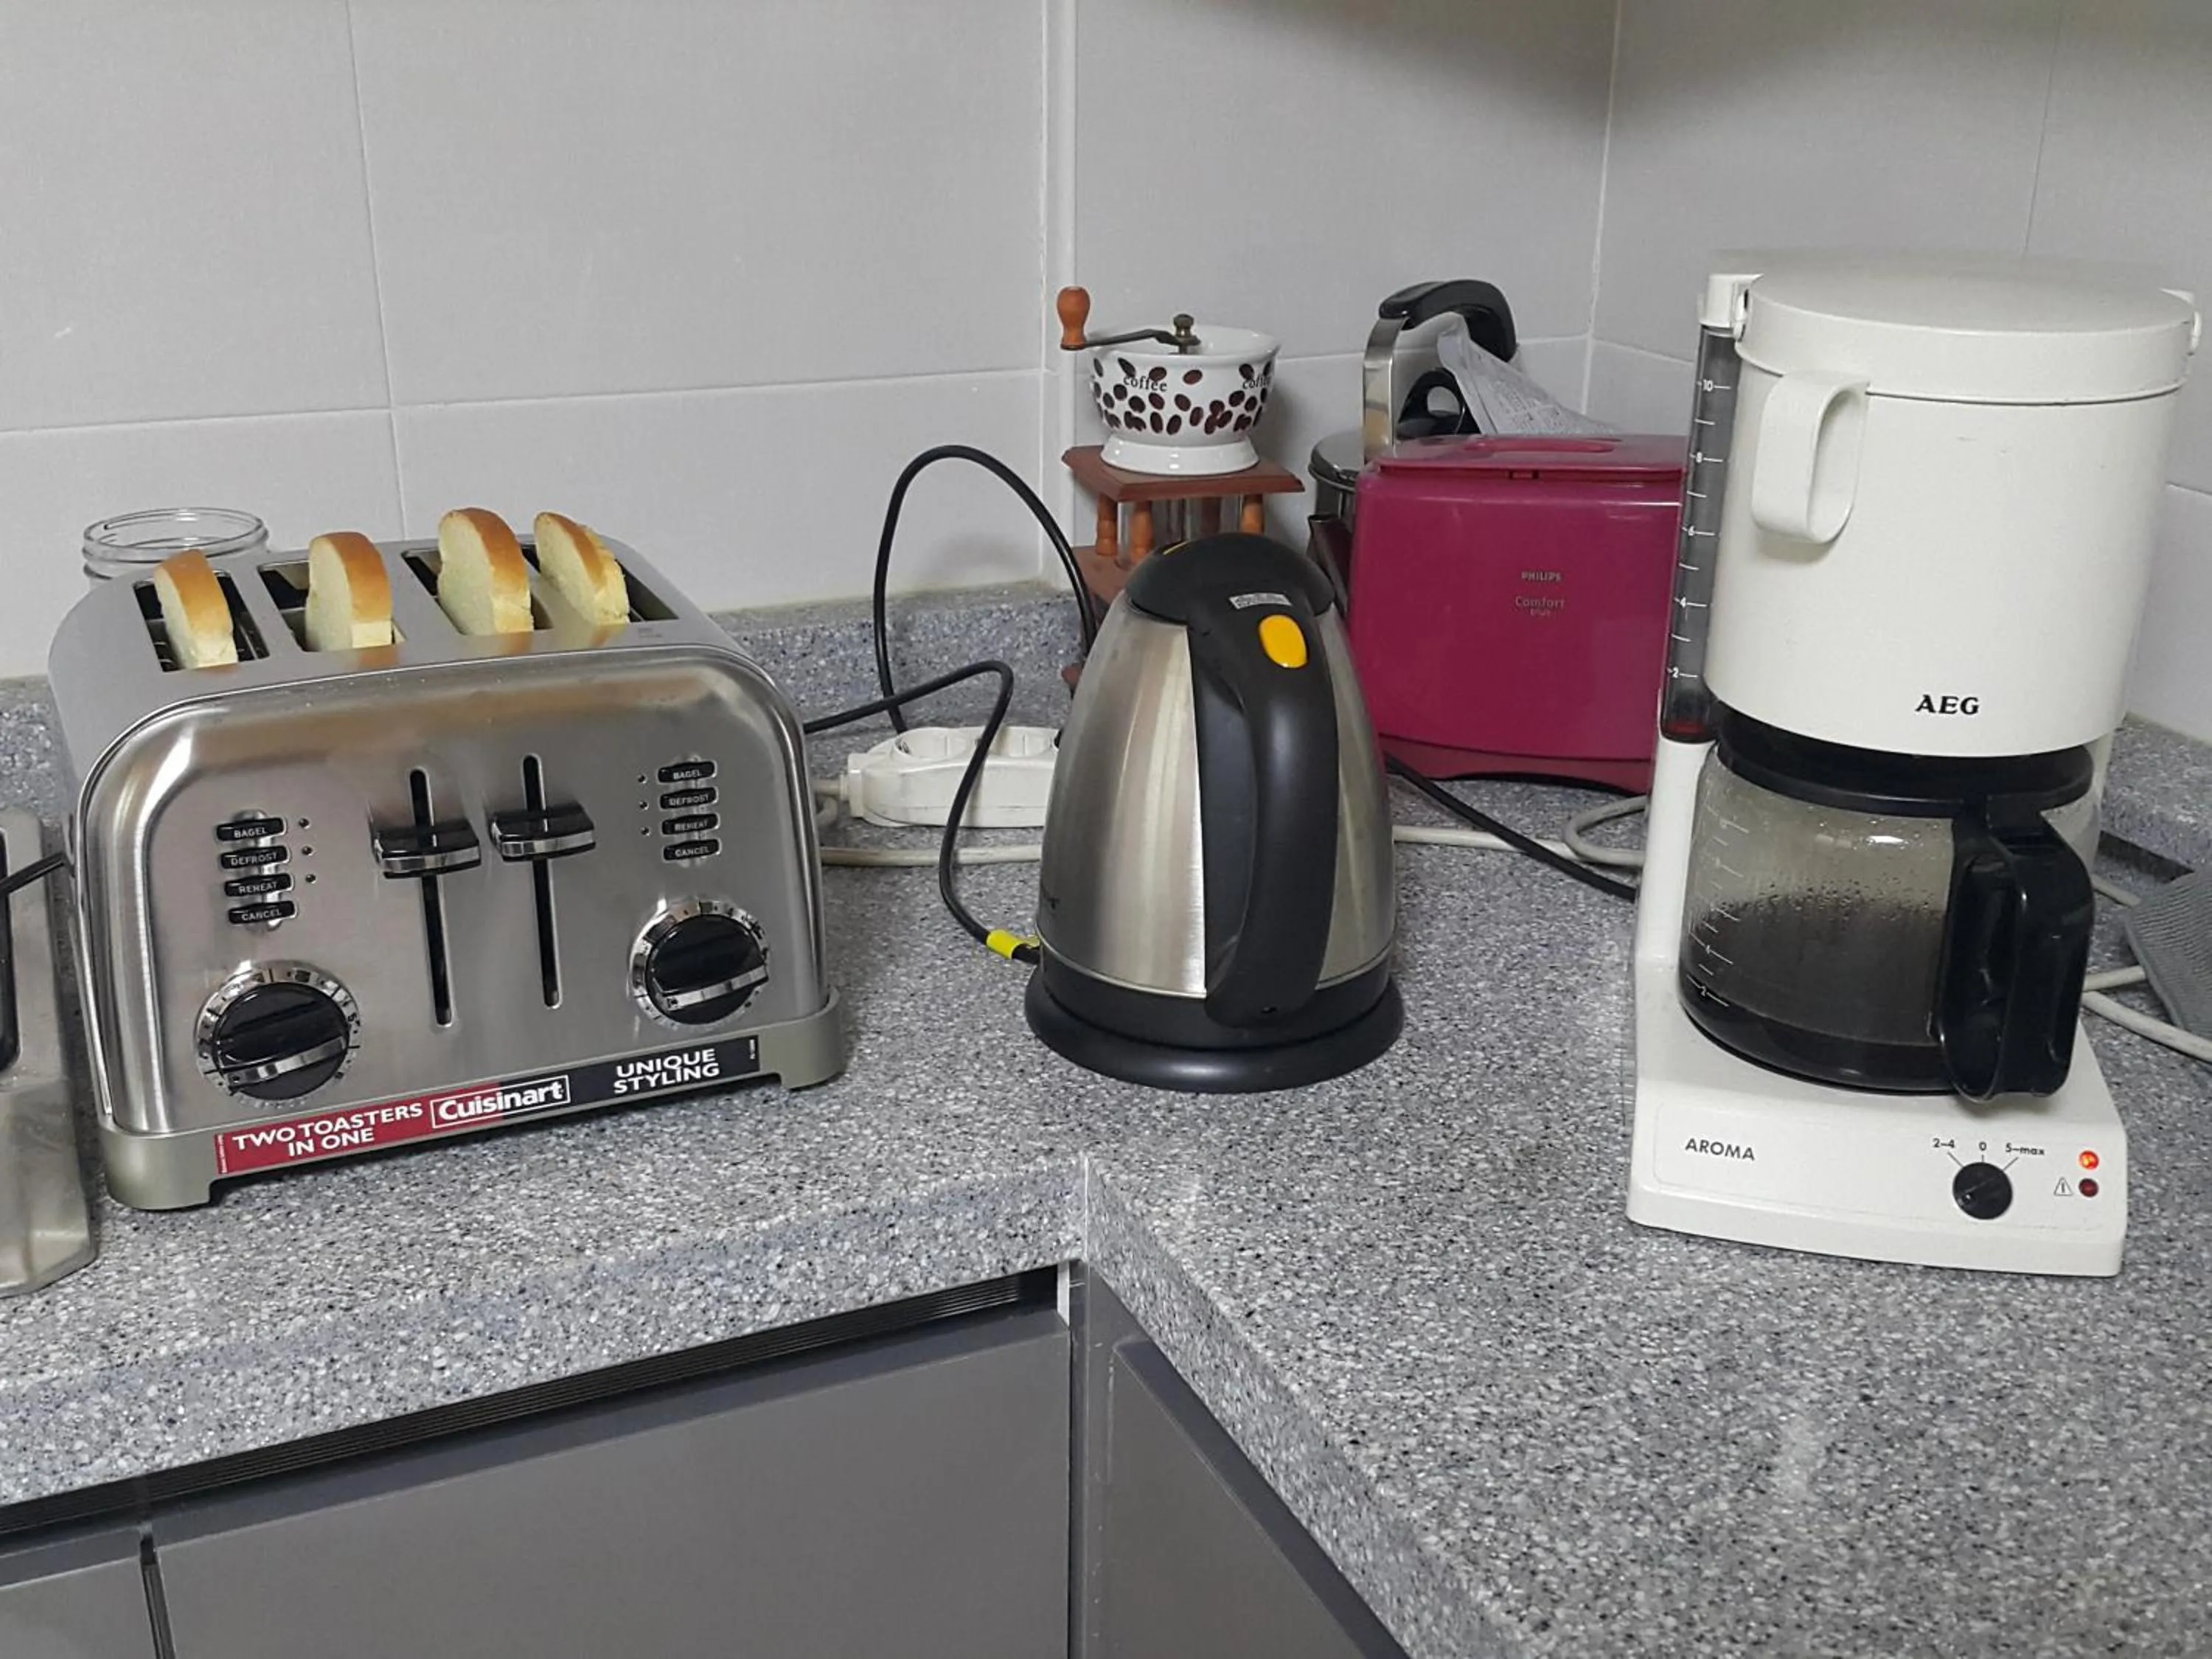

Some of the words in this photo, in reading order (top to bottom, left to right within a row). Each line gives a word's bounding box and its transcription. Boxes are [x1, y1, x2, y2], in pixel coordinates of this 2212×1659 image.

[1123, 375, 1167, 392] coffee
[1703, 379, 1714, 392] 10
[1521, 571, 1562, 582] PHILIPS
[1515, 596, 1565, 608] Comfort
[1672, 667, 1679, 678] 2
[1914, 694, 1980, 715] AEG
[673, 769, 701, 779] BAGEL
[669, 794, 709, 806] DEFROST
[234, 827, 267, 838] BAGEL
[675, 846, 709, 857] CANCEL
[231, 852, 277, 866] DEFROST
[238, 881, 277, 894] REHEAT
[241, 908, 282, 921] CANCEL
[616, 1048, 715, 1078] UNIQUE
[613, 1062, 720, 1094] STYLING
[439, 1080, 563, 1121] Cuisinart
[232, 1127, 296, 1150] TWO
[298, 1102, 423, 1138] TOASTERS
[288, 1141, 314, 1157] IN
[321, 1127, 375, 1150] ONE
[1933, 1138, 1955, 1149] 2-4
[2005, 1142, 2045, 1155] 5-max
[1685, 1138, 1755, 1161] AROMA
